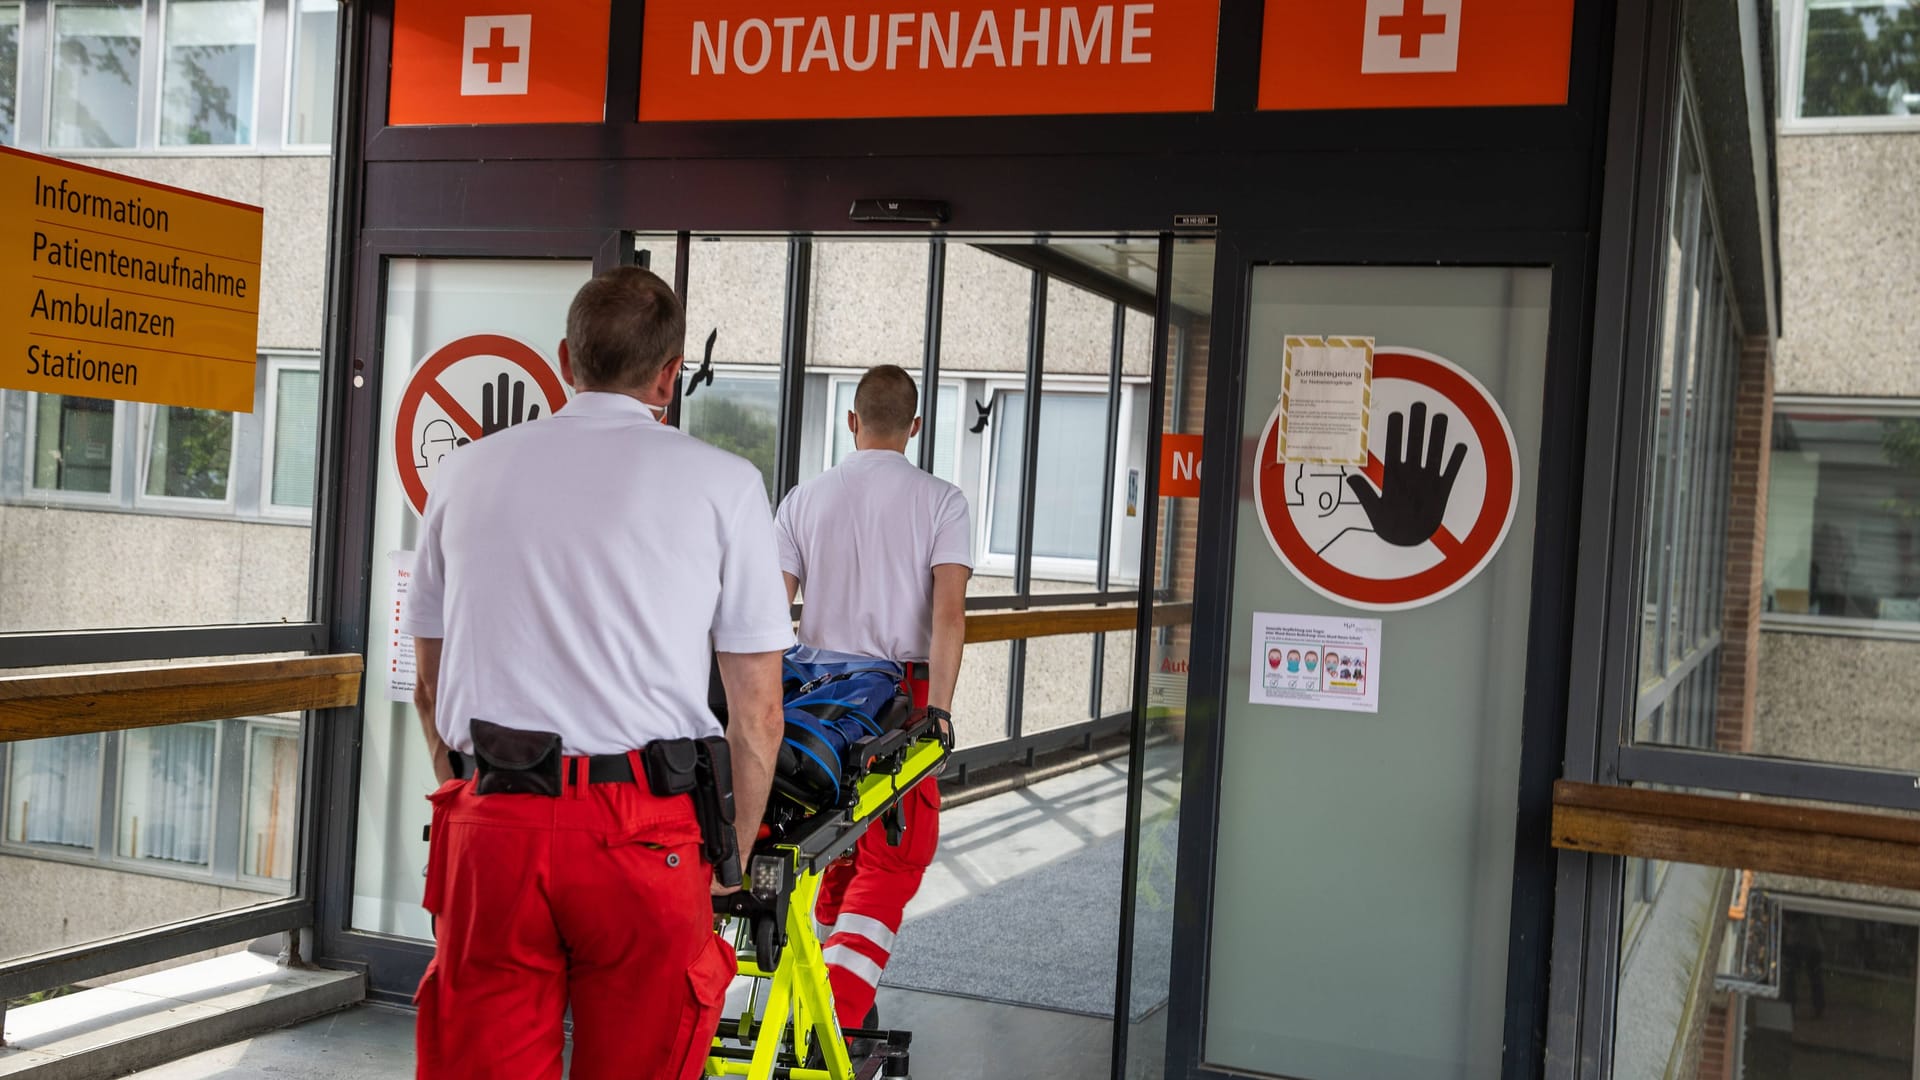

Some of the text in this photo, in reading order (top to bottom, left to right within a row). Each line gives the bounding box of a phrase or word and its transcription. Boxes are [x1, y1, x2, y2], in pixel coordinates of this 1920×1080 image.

[690, 4, 1154, 75] NOTAUFNAHME
[35, 175, 169, 232] Information
[33, 231, 247, 298] Patientenaufnahme
[30, 289, 175, 338] Ambulanzen
[26, 344, 138, 386] Stationen
[1294, 369, 1362, 379] Zutrittsregelung
